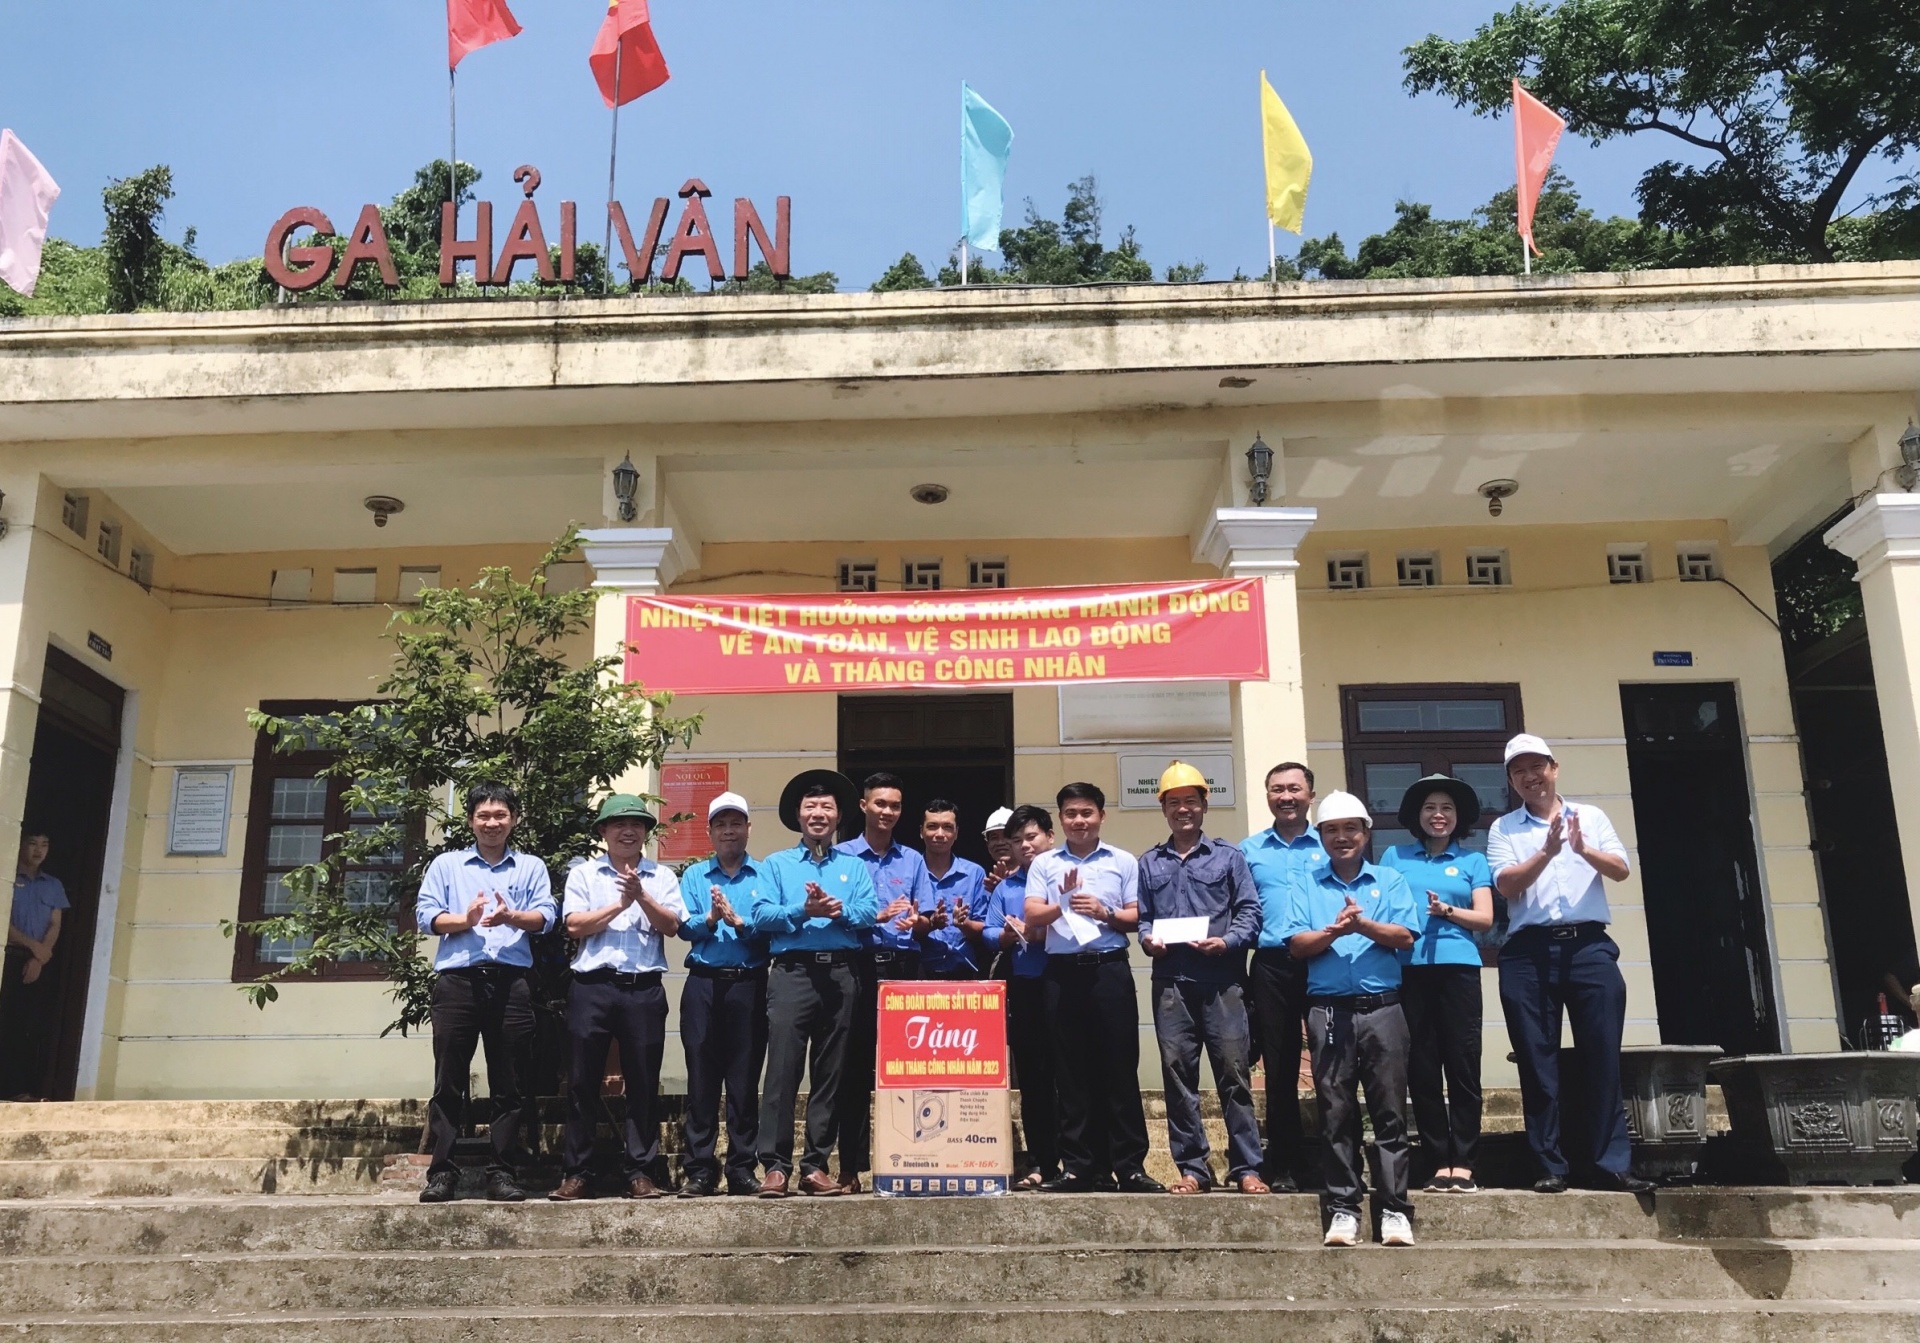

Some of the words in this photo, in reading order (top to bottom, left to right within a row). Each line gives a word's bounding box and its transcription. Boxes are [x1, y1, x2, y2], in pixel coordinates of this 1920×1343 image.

[264, 204, 400, 292] GA
[439, 164, 577, 287] HẢI
[607, 178, 791, 285] VÂN
[640, 603, 724, 632] NHIỆT
[799, 599, 897, 626] HƯỞNG
[906, 600, 965, 623] ỨNG
[975, 596, 1070, 620] THÁNG
[1080, 593, 1159, 617] HÀNH
[1168, 589, 1250, 617] ĐỘNG
[763, 633, 803, 654] AN
[812, 628, 896, 655] TOÀN,
[905, 626, 939, 655] VỆ
[950, 628, 1018, 650] SINH
[1028, 626, 1081, 648] LAO
[1090, 621, 1171, 649] ĐỘNG
[784, 658, 821, 684] VÀ
[830, 657, 925, 683] THÁNG
[935, 655, 1014, 682] CÔNG
[1024, 652, 1106, 679] NHÂN
[1127, 786, 1149, 794] THÁNG
[1138, 778, 1158, 786] NHIỆT
[886, 991, 904, 1010] CÔNG
[905, 992, 925, 1010] ĐOÀN
[966, 991, 981, 1013] VIỆT
[983, 994, 999, 1010] NAM
[905, 1015, 979, 1056] Tặng
[886, 1058, 904, 1075] NHÂN
[905, 1058, 927, 1075] THÁNG
[928, 1058, 946, 1075] CÔNG
[947, 1058, 965, 1075] NHÂN
[967, 1058, 982, 1075] NĂM
[983, 1060, 999, 1075] 2023
[965, 1134, 997, 1144] 40cm
[903, 1160, 929, 1168] Bluetooth
